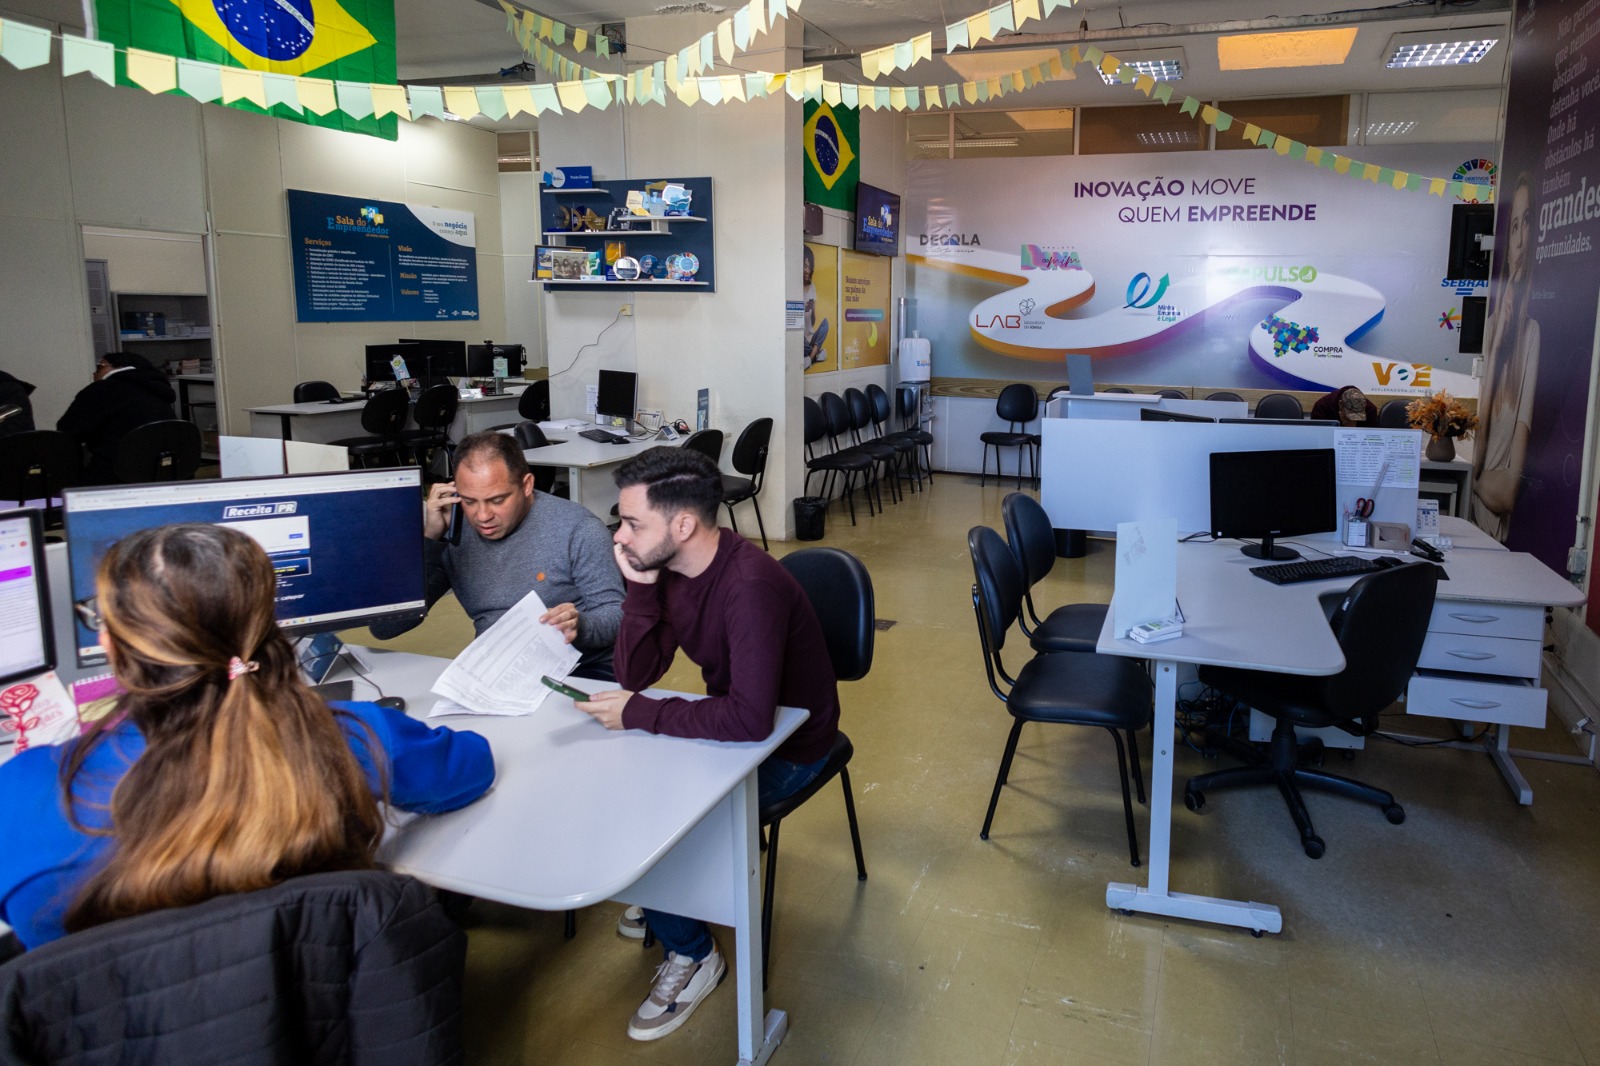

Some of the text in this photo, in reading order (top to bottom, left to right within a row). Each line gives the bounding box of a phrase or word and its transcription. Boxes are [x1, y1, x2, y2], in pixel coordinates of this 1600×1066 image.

[1552, 54, 1587, 93] obstáculo
[1547, 110, 1578, 144] Onde há
[1544, 127, 1595, 171] obstáculos há
[1074, 176, 1256, 201] INOVAÇÃO MOVE
[1542, 169, 1571, 195] também
[336, 215, 367, 226] Sala do
[1118, 204, 1317, 223] QUEM EMPREENDE
[327, 217, 389, 234] Empreendedor
[444, 221, 468, 229] negócio
[304, 237, 332, 247] Serviços
[1535, 232, 1592, 264] oportunidades.
[228, 503, 295, 517] Receita PR
